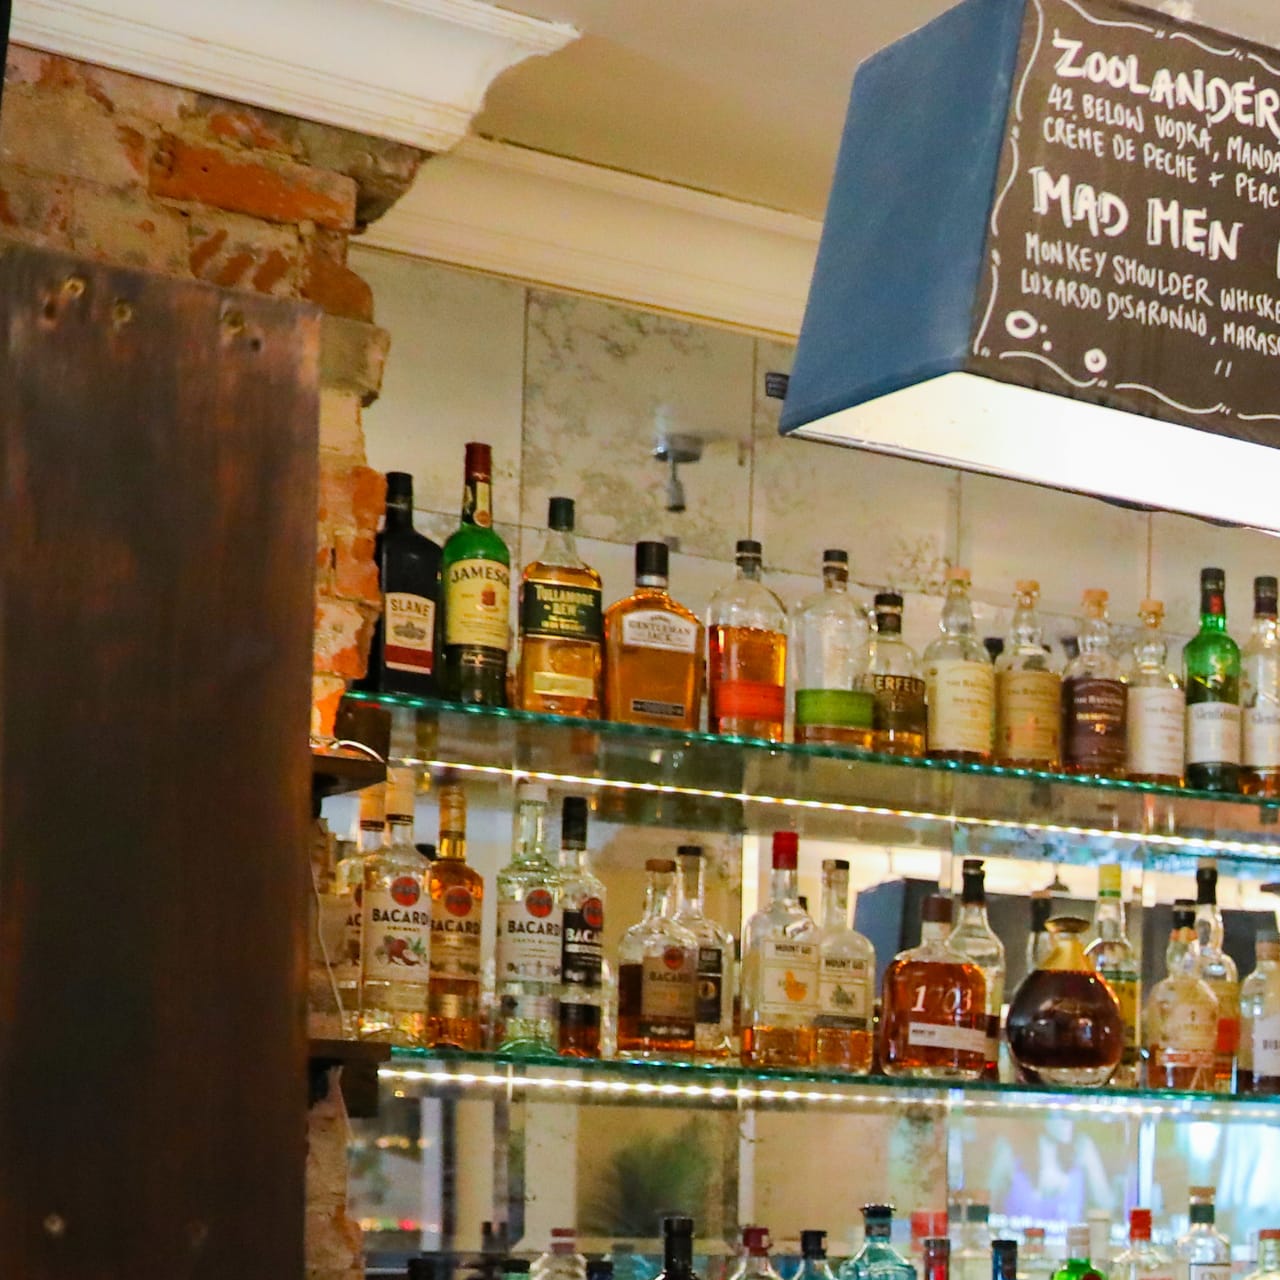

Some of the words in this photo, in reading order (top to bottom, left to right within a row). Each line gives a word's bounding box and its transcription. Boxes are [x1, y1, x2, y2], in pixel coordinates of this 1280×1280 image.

[1048, 83, 1074, 111] 42
[1082, 94, 1144, 133] BELOW
[1155, 115, 1219, 162] VODKA,
[1113, 134, 1136, 162] DE
[1143, 142, 1198, 184] PECHE
[1028, 165, 1129, 237] MAD
[1147, 197, 1244, 261] MEN
[1021, 268, 1102, 310] LUXARDO
[1025, 231, 1107, 278] MONKEY
[1112, 254, 1214, 307] SHOULDER
[390, 598, 430, 617] SLANE
[628, 619, 691, 636] GENTLEMAN
[372, 908, 429, 926] BACARD
